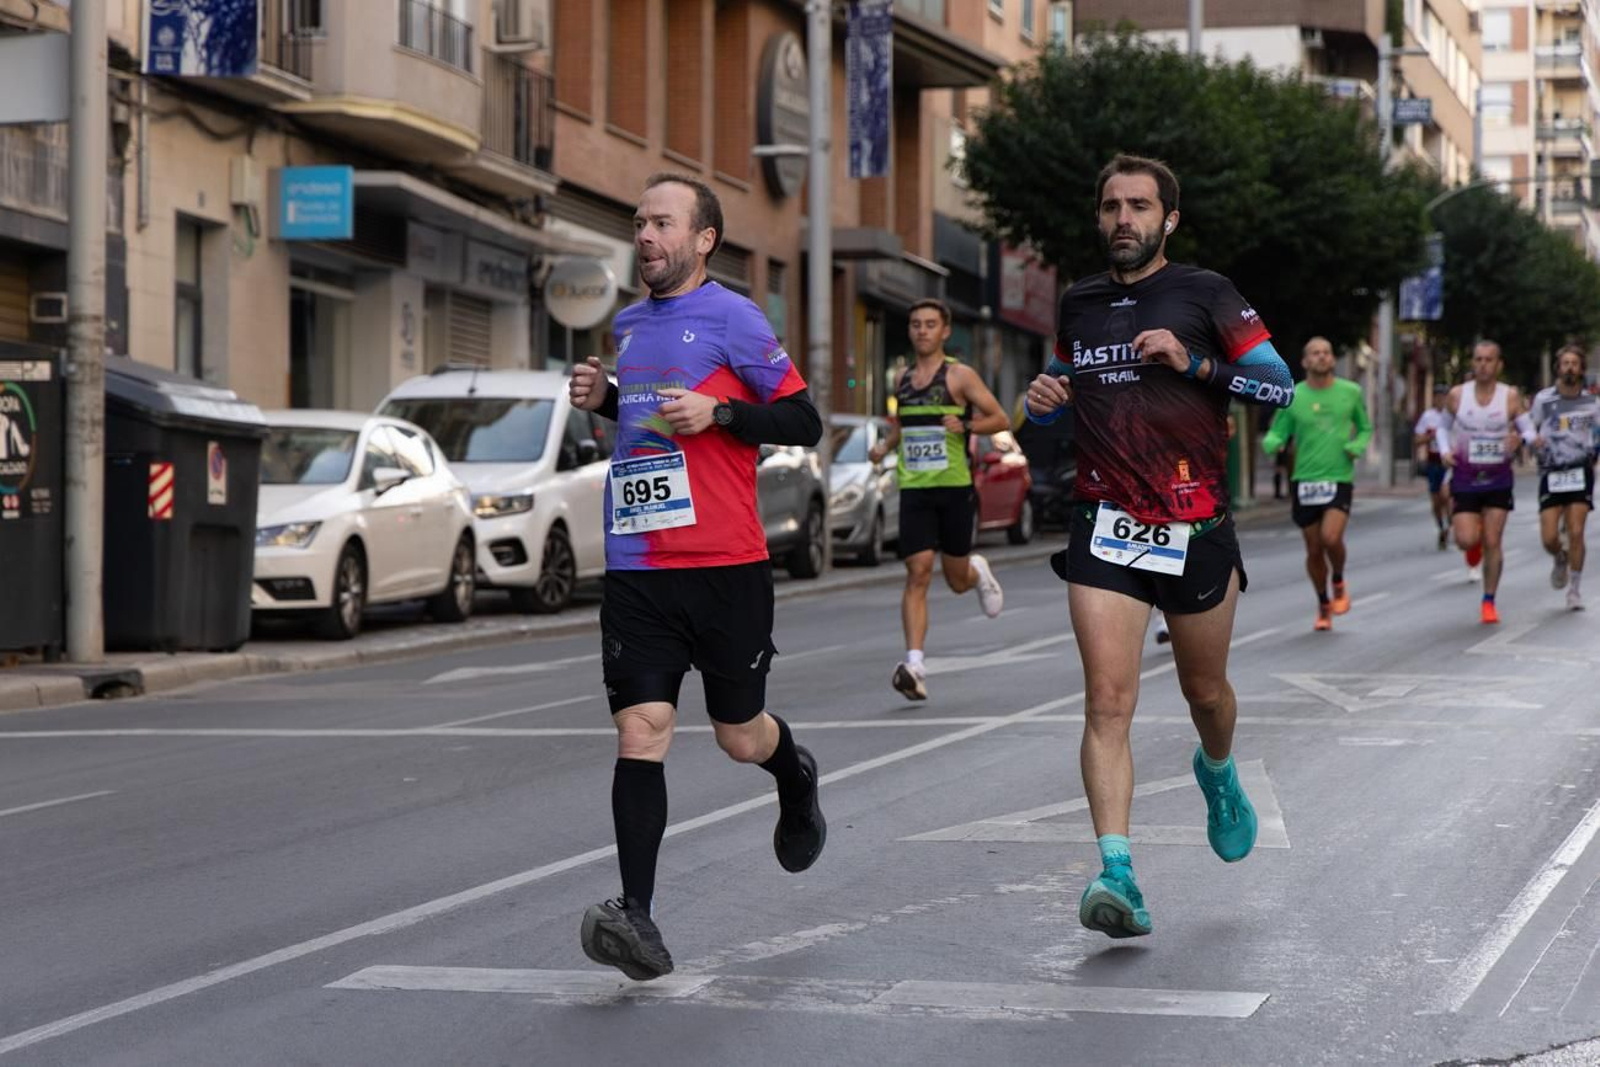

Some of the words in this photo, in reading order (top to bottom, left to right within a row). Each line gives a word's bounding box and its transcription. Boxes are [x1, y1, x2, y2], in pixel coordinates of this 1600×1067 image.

[1073, 340, 1081, 350] EL
[1098, 370, 1140, 385] TRAIL
[1228, 376, 1294, 406] SPORT
[907, 443, 943, 458] 1025
[623, 476, 671, 506] 695
[1113, 517, 1171, 546] 626
